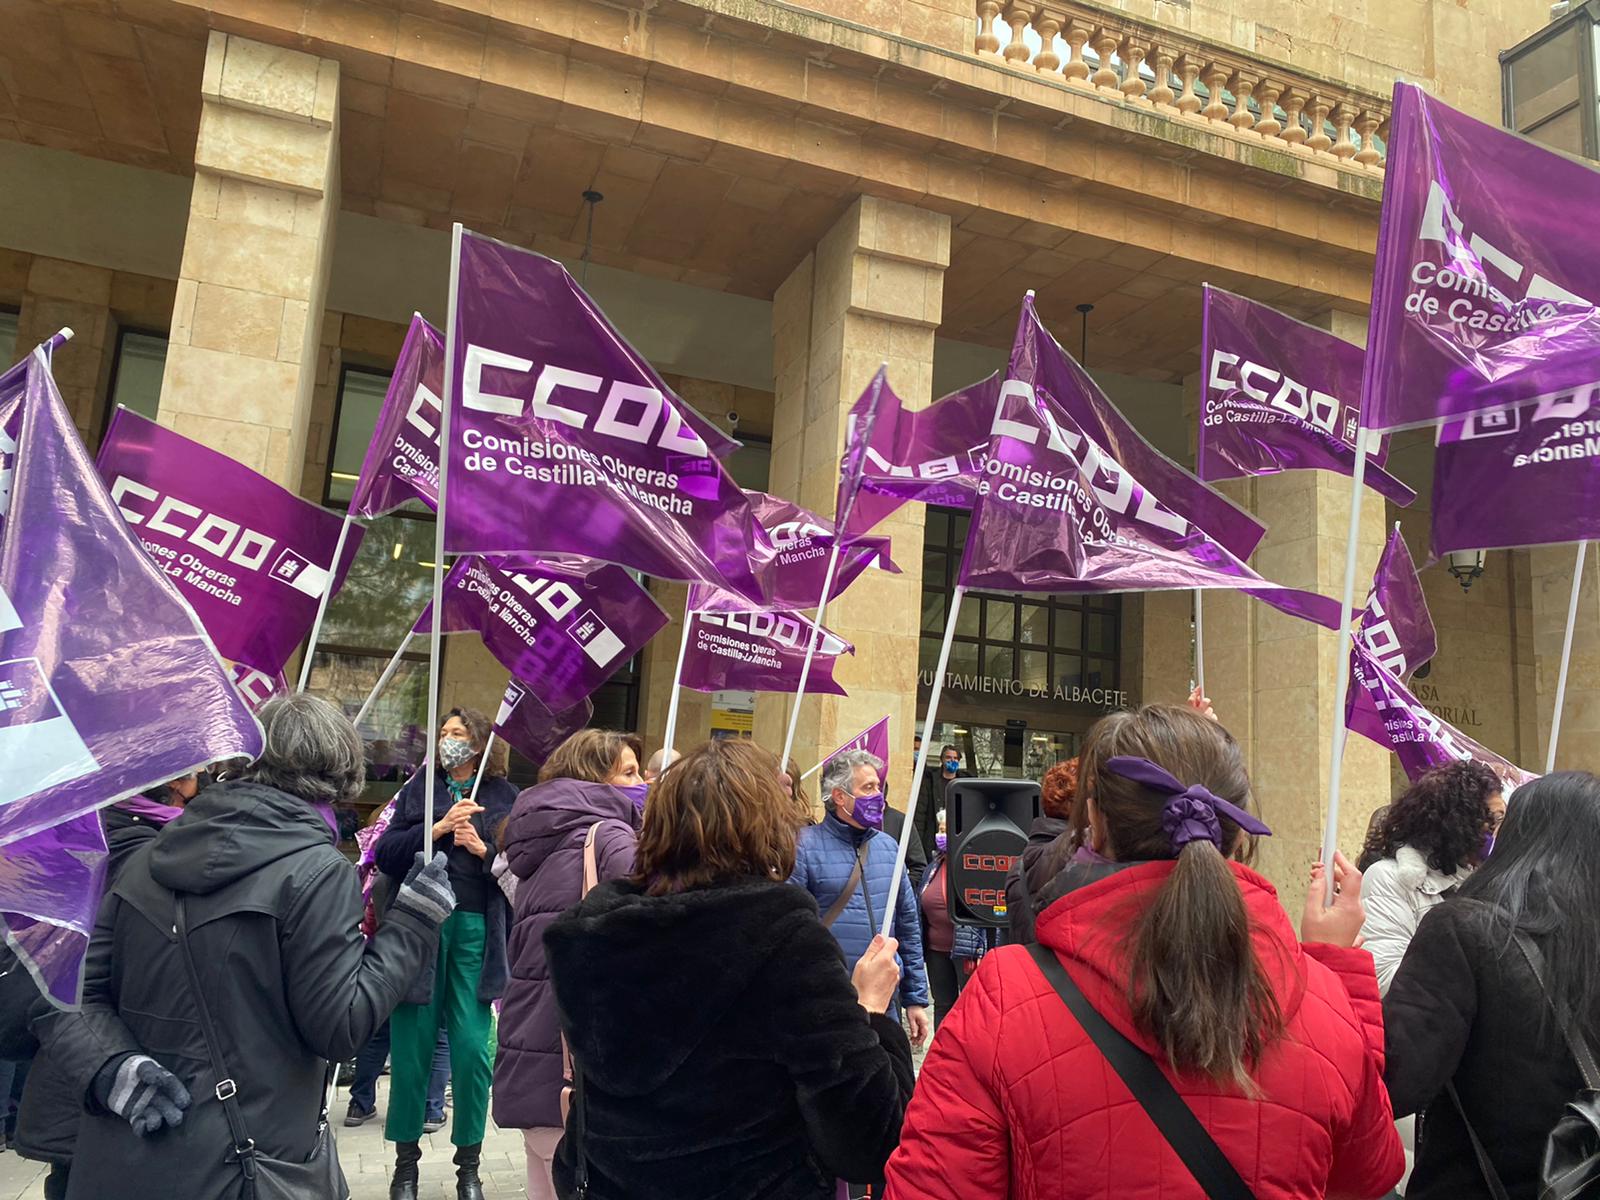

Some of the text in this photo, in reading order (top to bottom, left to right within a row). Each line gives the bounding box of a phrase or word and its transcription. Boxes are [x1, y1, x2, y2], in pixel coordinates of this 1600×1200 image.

[1405, 290, 1439, 315] de
[462, 343, 708, 458] CCOO
[1209, 349, 1340, 435] CCOO
[1204, 414, 1223, 426] de
[463, 429, 679, 489] Comisiones Obreras
[464, 452, 497, 471] de
[625, 480, 693, 516] Mancha
[985, 459, 1092, 512] omisiones
[110, 475, 276, 571] CCOO
[180, 553, 238, 588] Obreras
[780, 546, 826, 565] Mancha
[184, 569, 242, 606] Mancha
[499, 590, 537, 628] Obreras
[697, 641, 708, 650] de
[698, 629, 750, 651] Comisiones
[917, 670, 1128, 707] YUTAMIENTO DE ALBACETE
[1411, 682, 1440, 702] ASA
